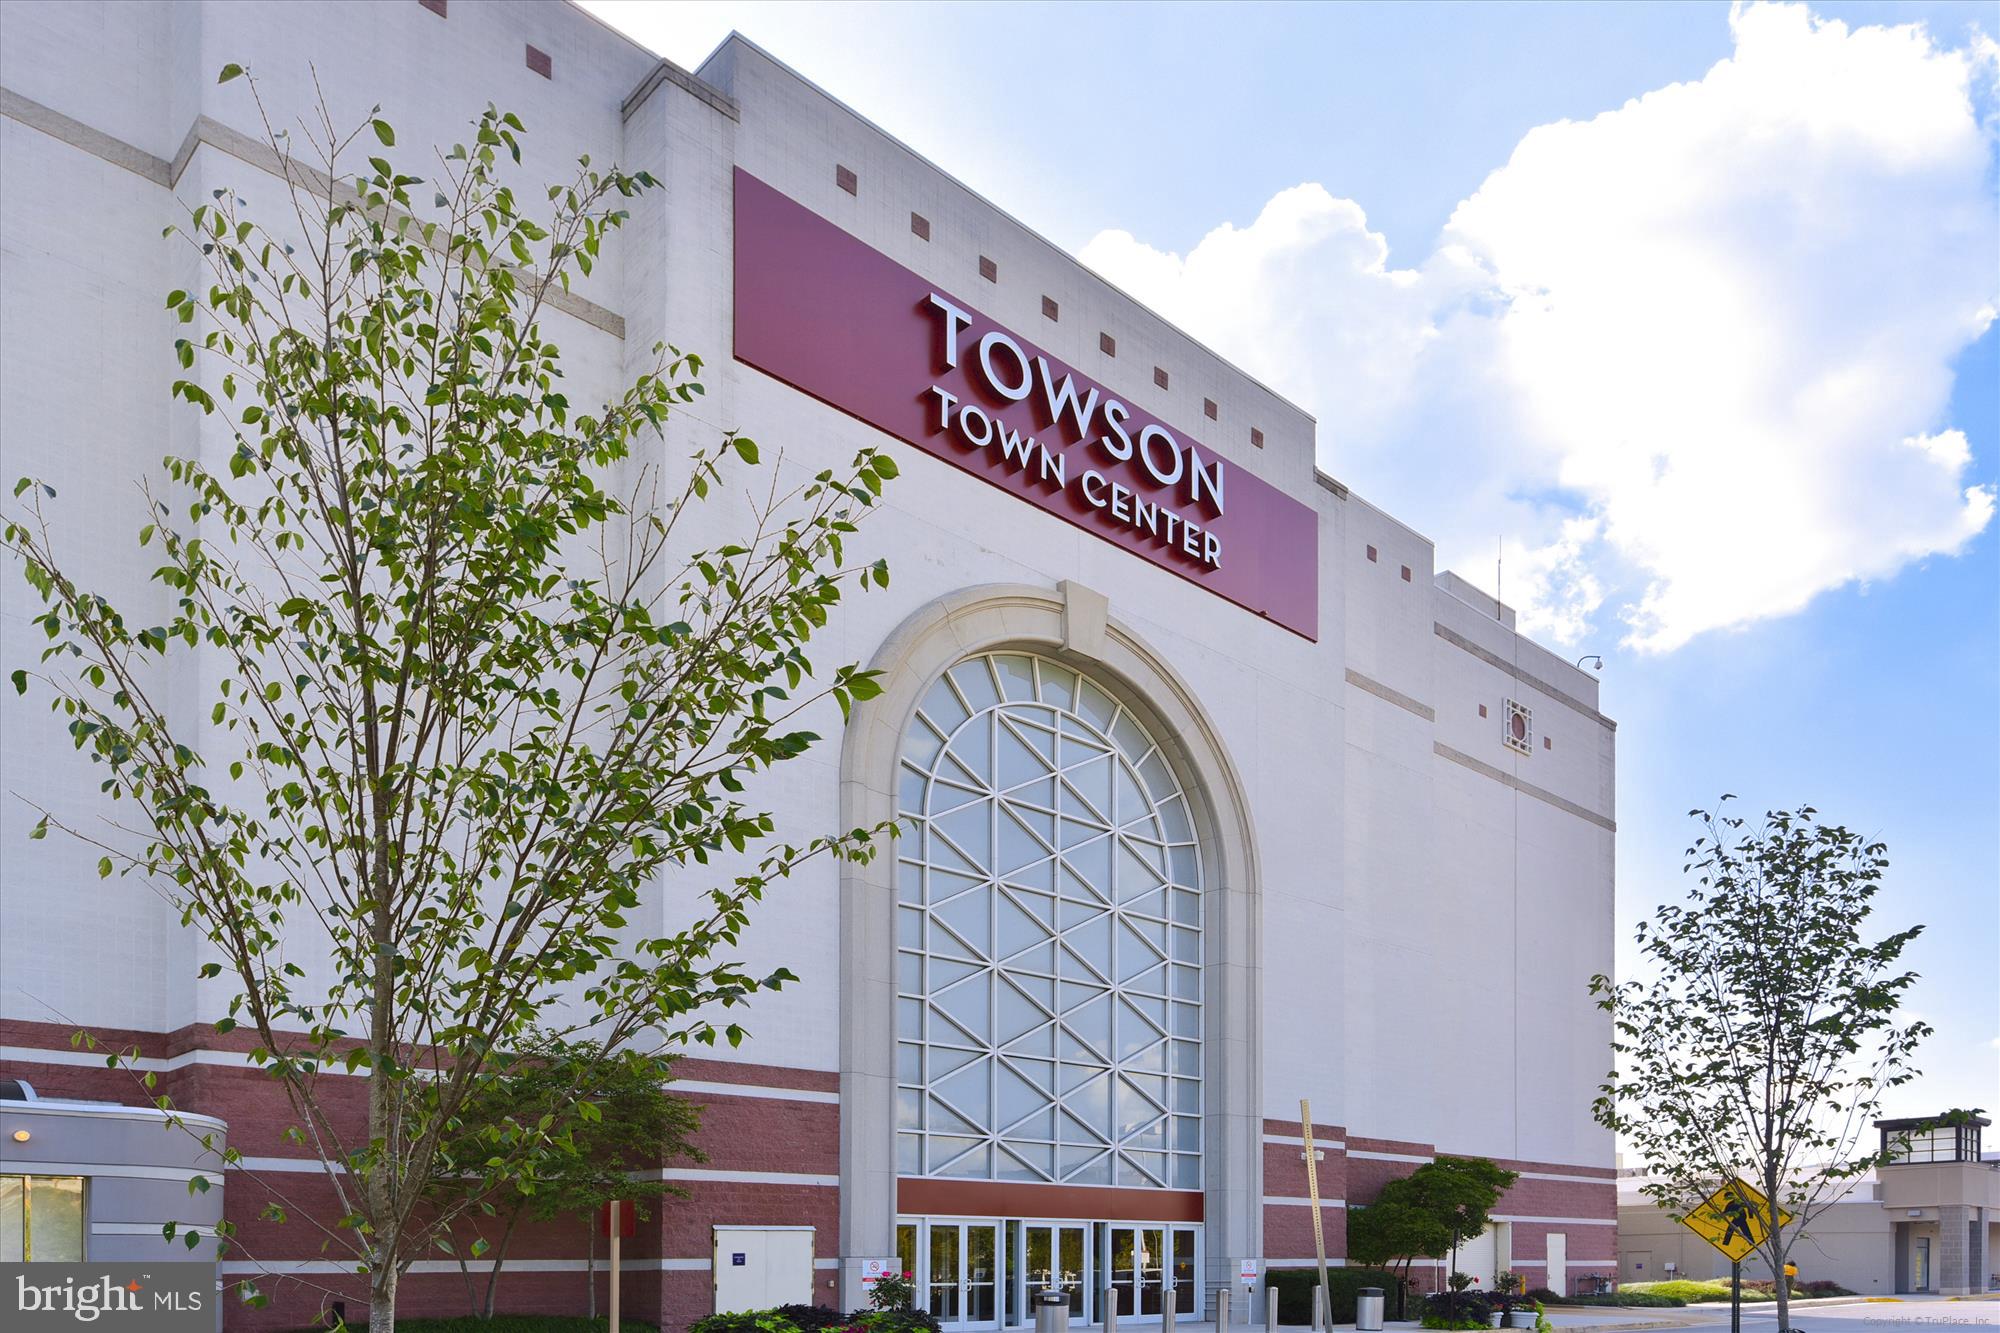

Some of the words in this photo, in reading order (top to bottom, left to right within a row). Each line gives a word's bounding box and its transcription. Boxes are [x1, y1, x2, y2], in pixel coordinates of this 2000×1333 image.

[930, 292, 1224, 516] TOWSON
[932, 385, 1065, 489] TOWN
[1082, 469, 1221, 569] CENTER
